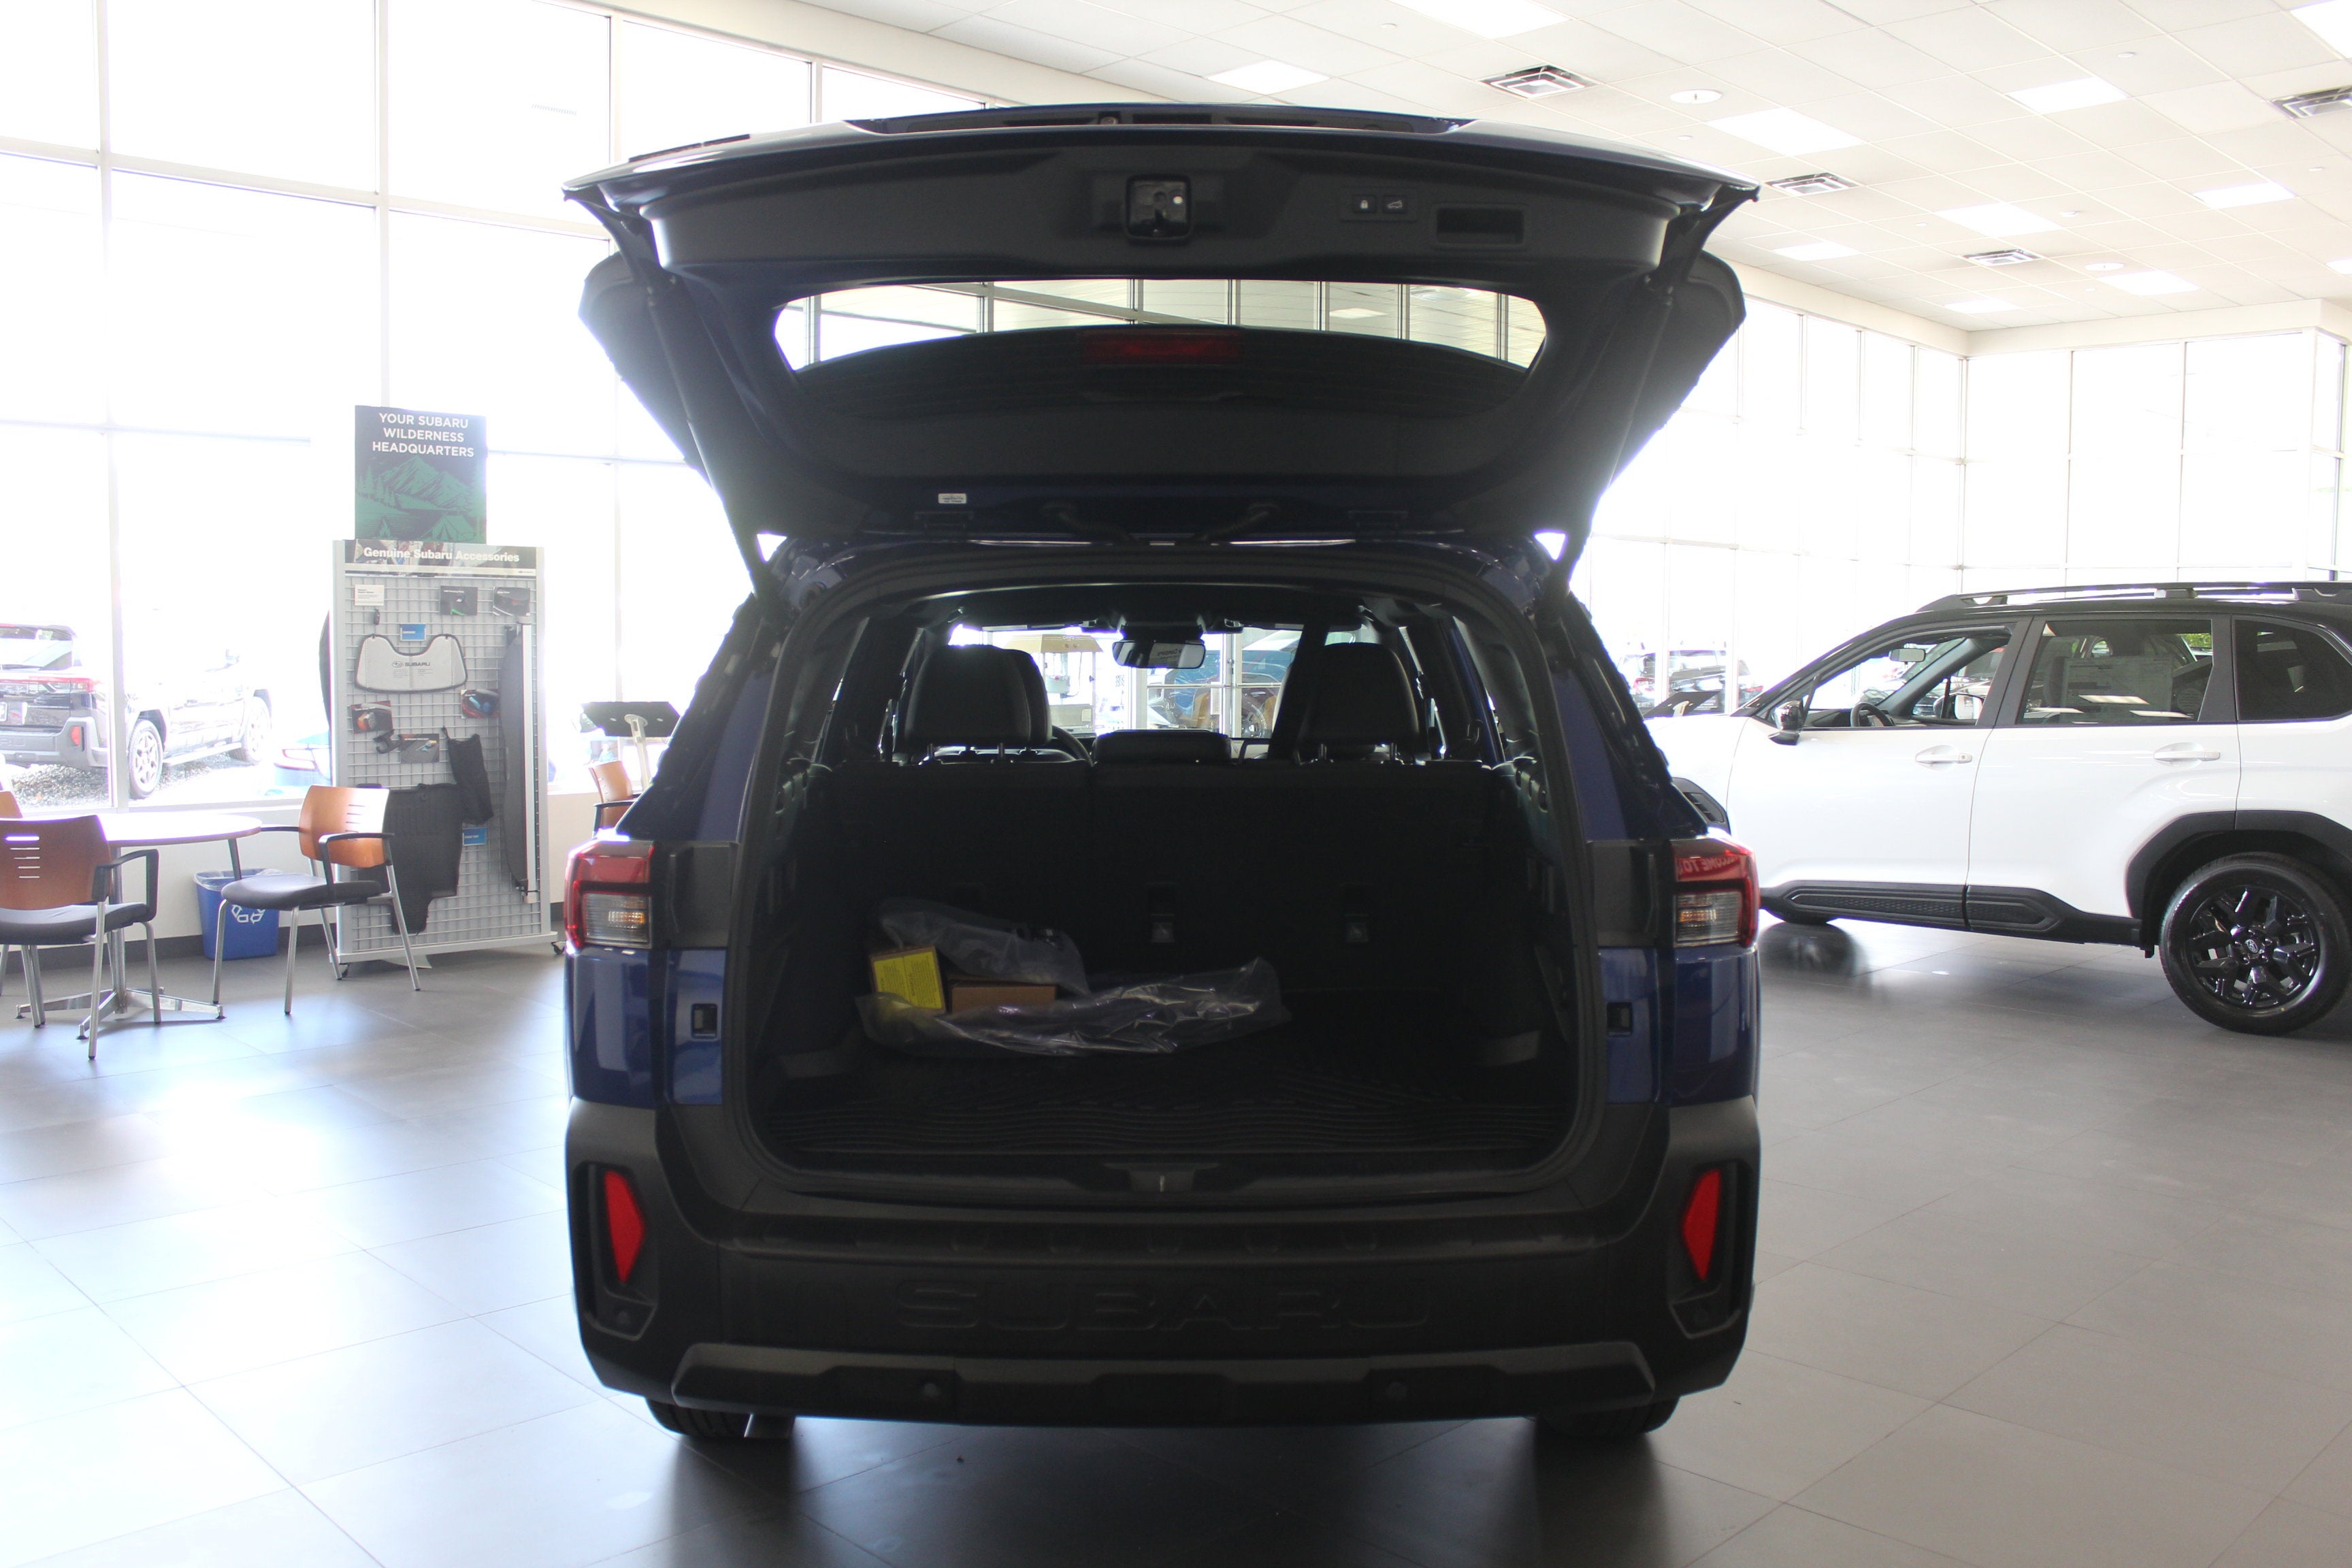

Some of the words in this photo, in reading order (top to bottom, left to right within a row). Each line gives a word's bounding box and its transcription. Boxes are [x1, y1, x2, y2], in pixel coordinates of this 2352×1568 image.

[379, 412, 414, 426] YOUR
[418, 415, 469, 429] SUBARU
[383, 427, 464, 443] WILDERNESS
[372, 441, 474, 458] HEADQUARTERS
[363, 547, 410, 559] Genuine
[413, 549, 453, 561] Subaru
[456, 551, 520, 563] Accessories
[897, 1278, 1431, 1332] SUBARU
